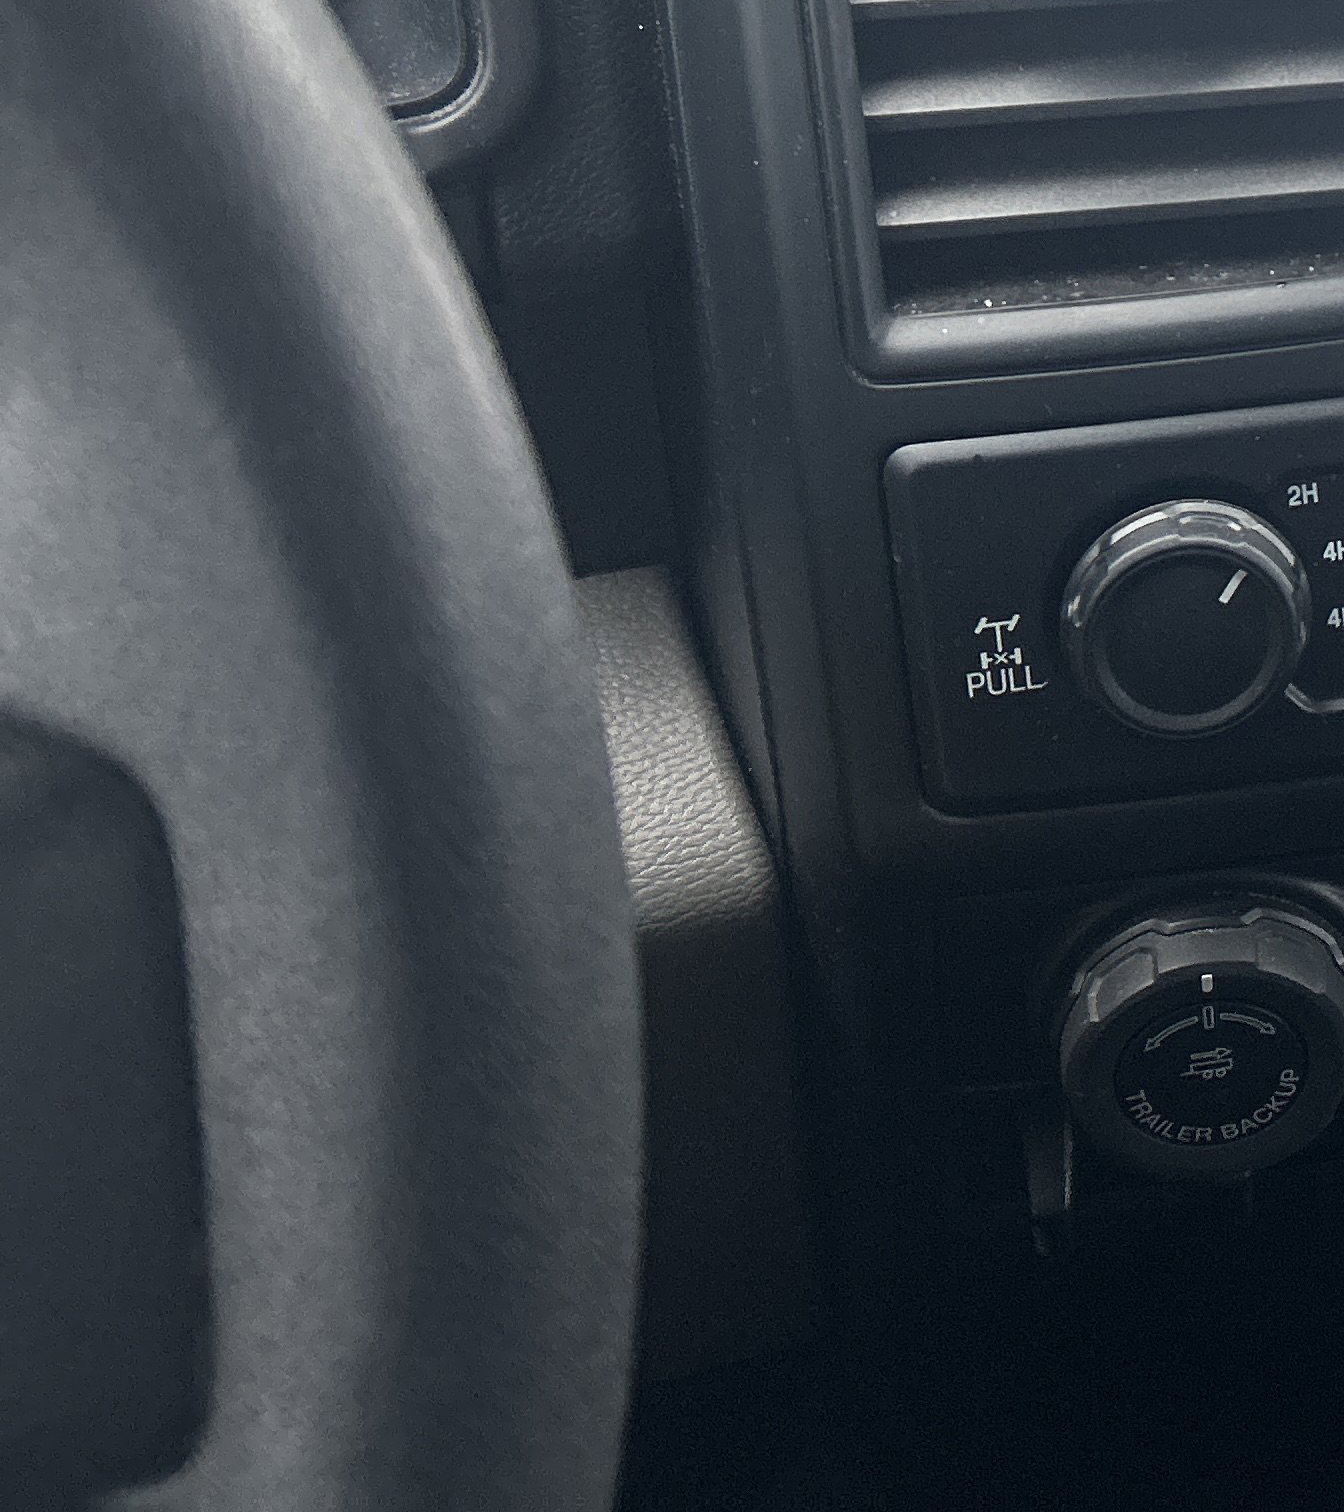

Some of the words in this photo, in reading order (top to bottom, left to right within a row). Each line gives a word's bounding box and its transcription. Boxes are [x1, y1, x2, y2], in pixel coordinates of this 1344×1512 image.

[1287, 482, 1319, 507] 2H
[966, 665, 1049, 698] PULL
[1126, 1090, 1212, 1143] TRAILER
[1220, 1069, 1299, 1138] BACKUP
